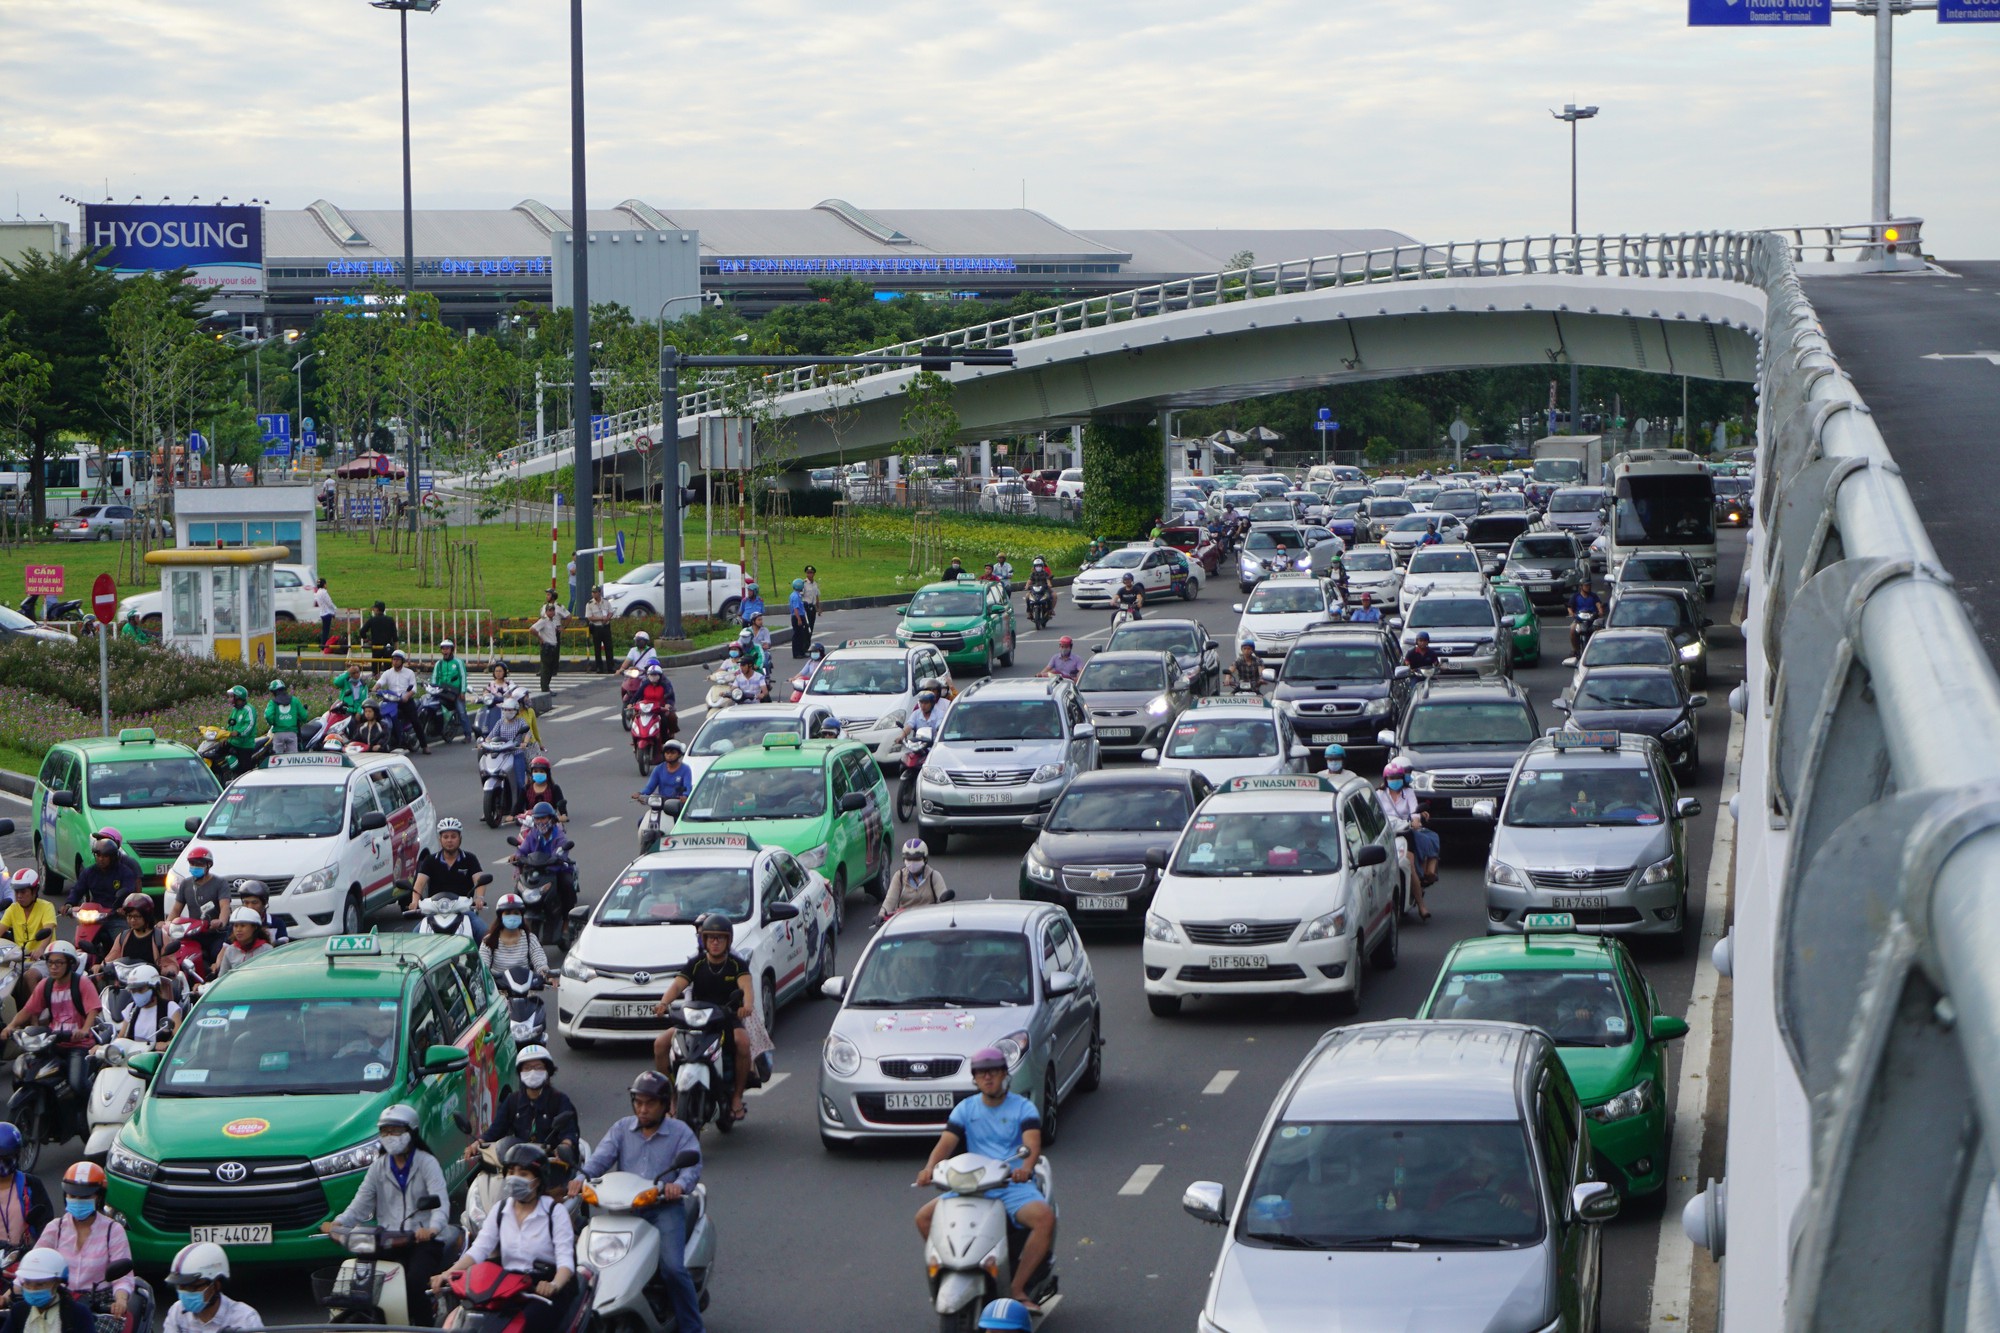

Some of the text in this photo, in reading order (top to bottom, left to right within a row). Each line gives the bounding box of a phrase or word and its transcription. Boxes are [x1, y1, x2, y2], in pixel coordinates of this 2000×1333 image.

[1750, 11, 1811, 21] Domestic Terminal
[94, 221, 248, 249] HYOSUNG
[717, 257, 1016, 271] TAN SON NHAT INTERNATIONAL TERMINAL
[240, 275, 257, 285] side
